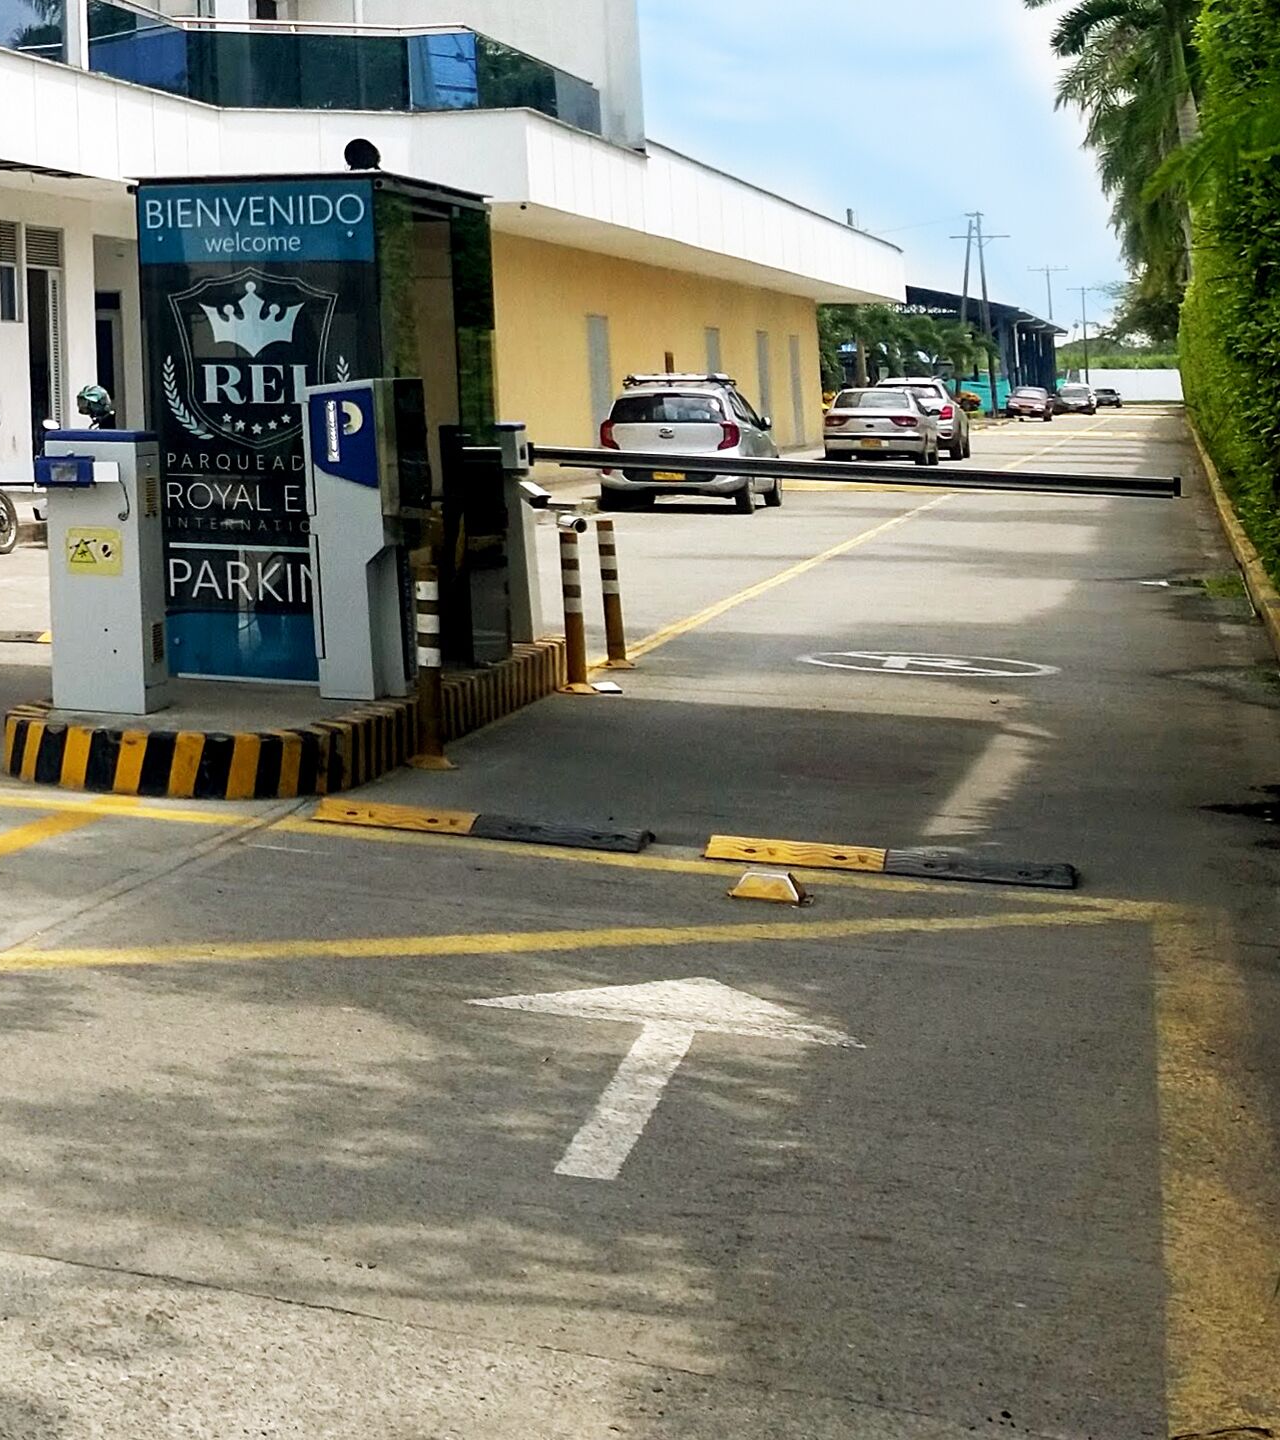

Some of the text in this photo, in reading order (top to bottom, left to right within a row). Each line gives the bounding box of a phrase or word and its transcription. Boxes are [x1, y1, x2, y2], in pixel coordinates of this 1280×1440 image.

[145, 193, 365, 229] BIENVENIDO
[204, 231, 302, 253] welcome
[166, 482, 272, 512] ROYAL
